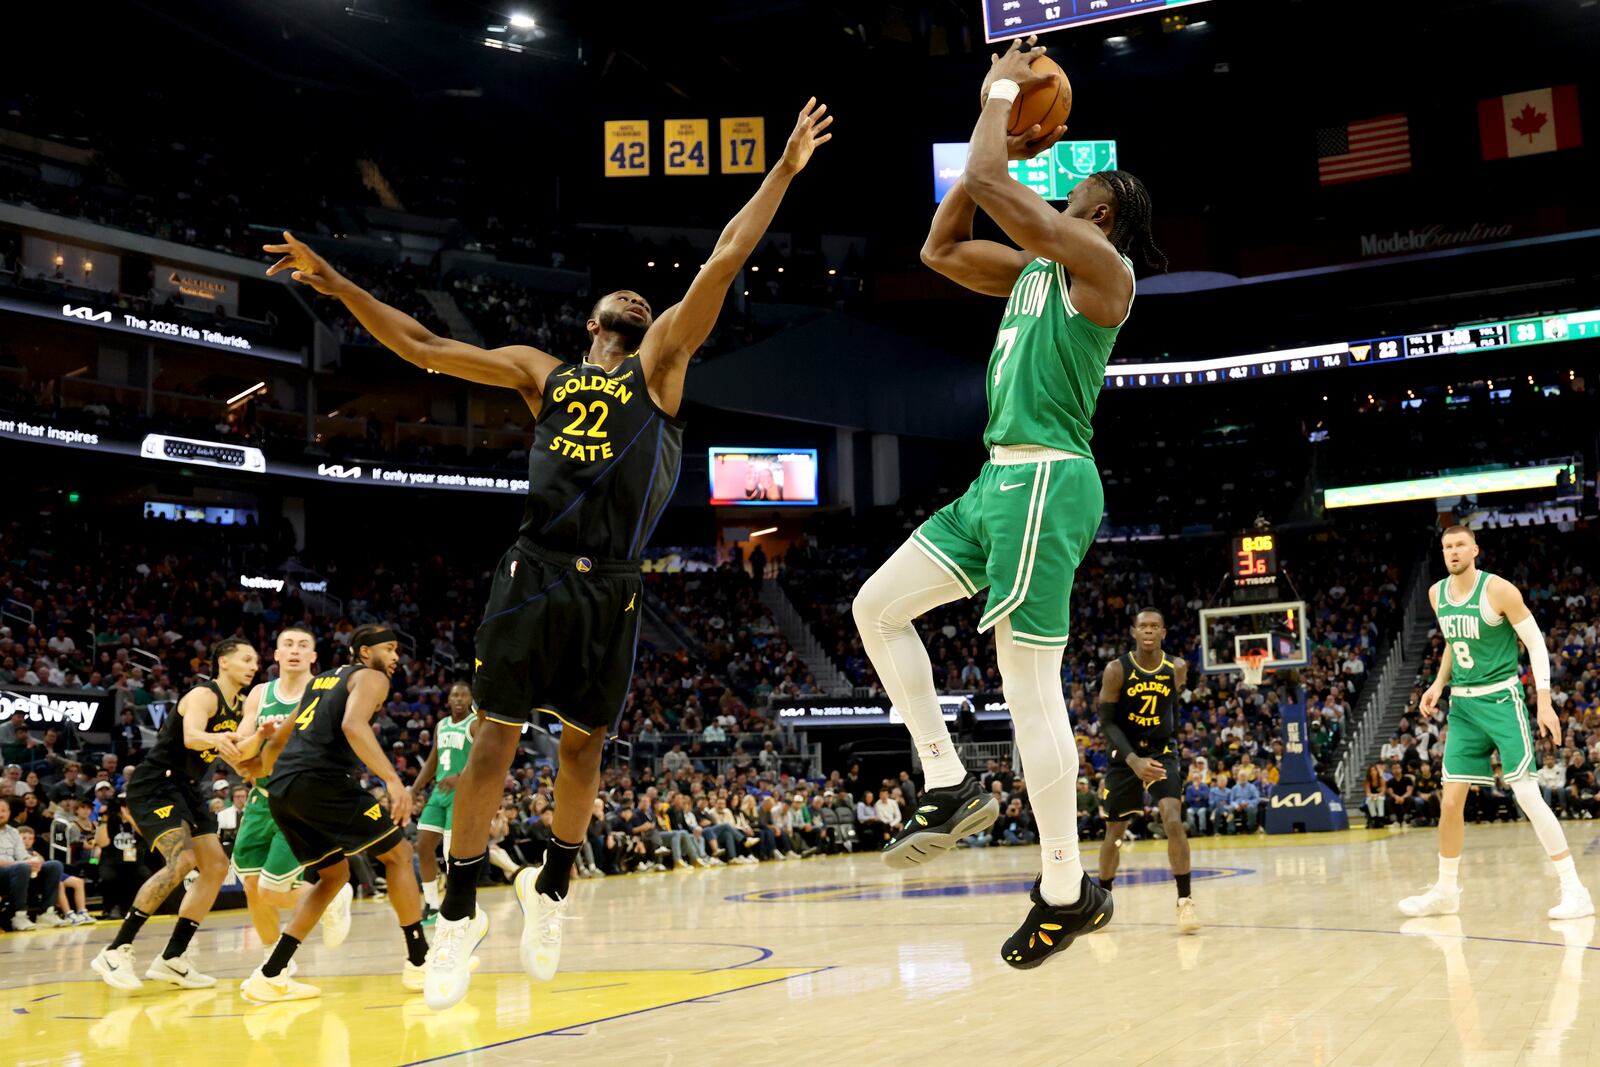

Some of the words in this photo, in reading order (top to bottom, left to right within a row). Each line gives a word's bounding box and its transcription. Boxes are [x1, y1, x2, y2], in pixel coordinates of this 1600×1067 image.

[609, 142, 645, 169] 42
[669, 140, 704, 168] 24
[730, 138, 756, 166] 17
[1360, 229, 1425, 257] Modelo
[1005, 271, 1053, 318] STON
[124, 314, 147, 329] The
[149, 319, 179, 336] 2025
[181, 325, 200, 340] Kia
[202, 329, 251, 350] Telluride.
[994, 326, 1019, 389] 7
[1379, 341, 1398, 359] 22
[552, 375, 633, 405] GOLDEN
[562, 400, 609, 438] 22
[17, 421, 45, 438] that
[47, 426, 99, 445] inspires
[549, 436, 614, 461] STATE
[372, 468, 382, 479] If
[383, 469, 408, 484] only
[409, 472, 436, 484] your
[437, 474, 466, 486] seats
[467, 476, 494, 488] were
[495, 478, 509, 489] as
[510, 479, 529, 491] goo
[1242, 535, 1273, 552] 8:06
[1238, 551, 1266, 576] 3.6
[1245, 576, 1276, 586] TISSOT
[1453, 641, 1474, 669] 8
[1127, 681, 1171, 697] GOLDEN
[0, 694, 99, 731] betway
[295, 696, 320, 731] 4
[1139, 695, 1157, 715] 71
[1128, 712, 1160, 726] STATE
[440, 749, 451, 771] 4
